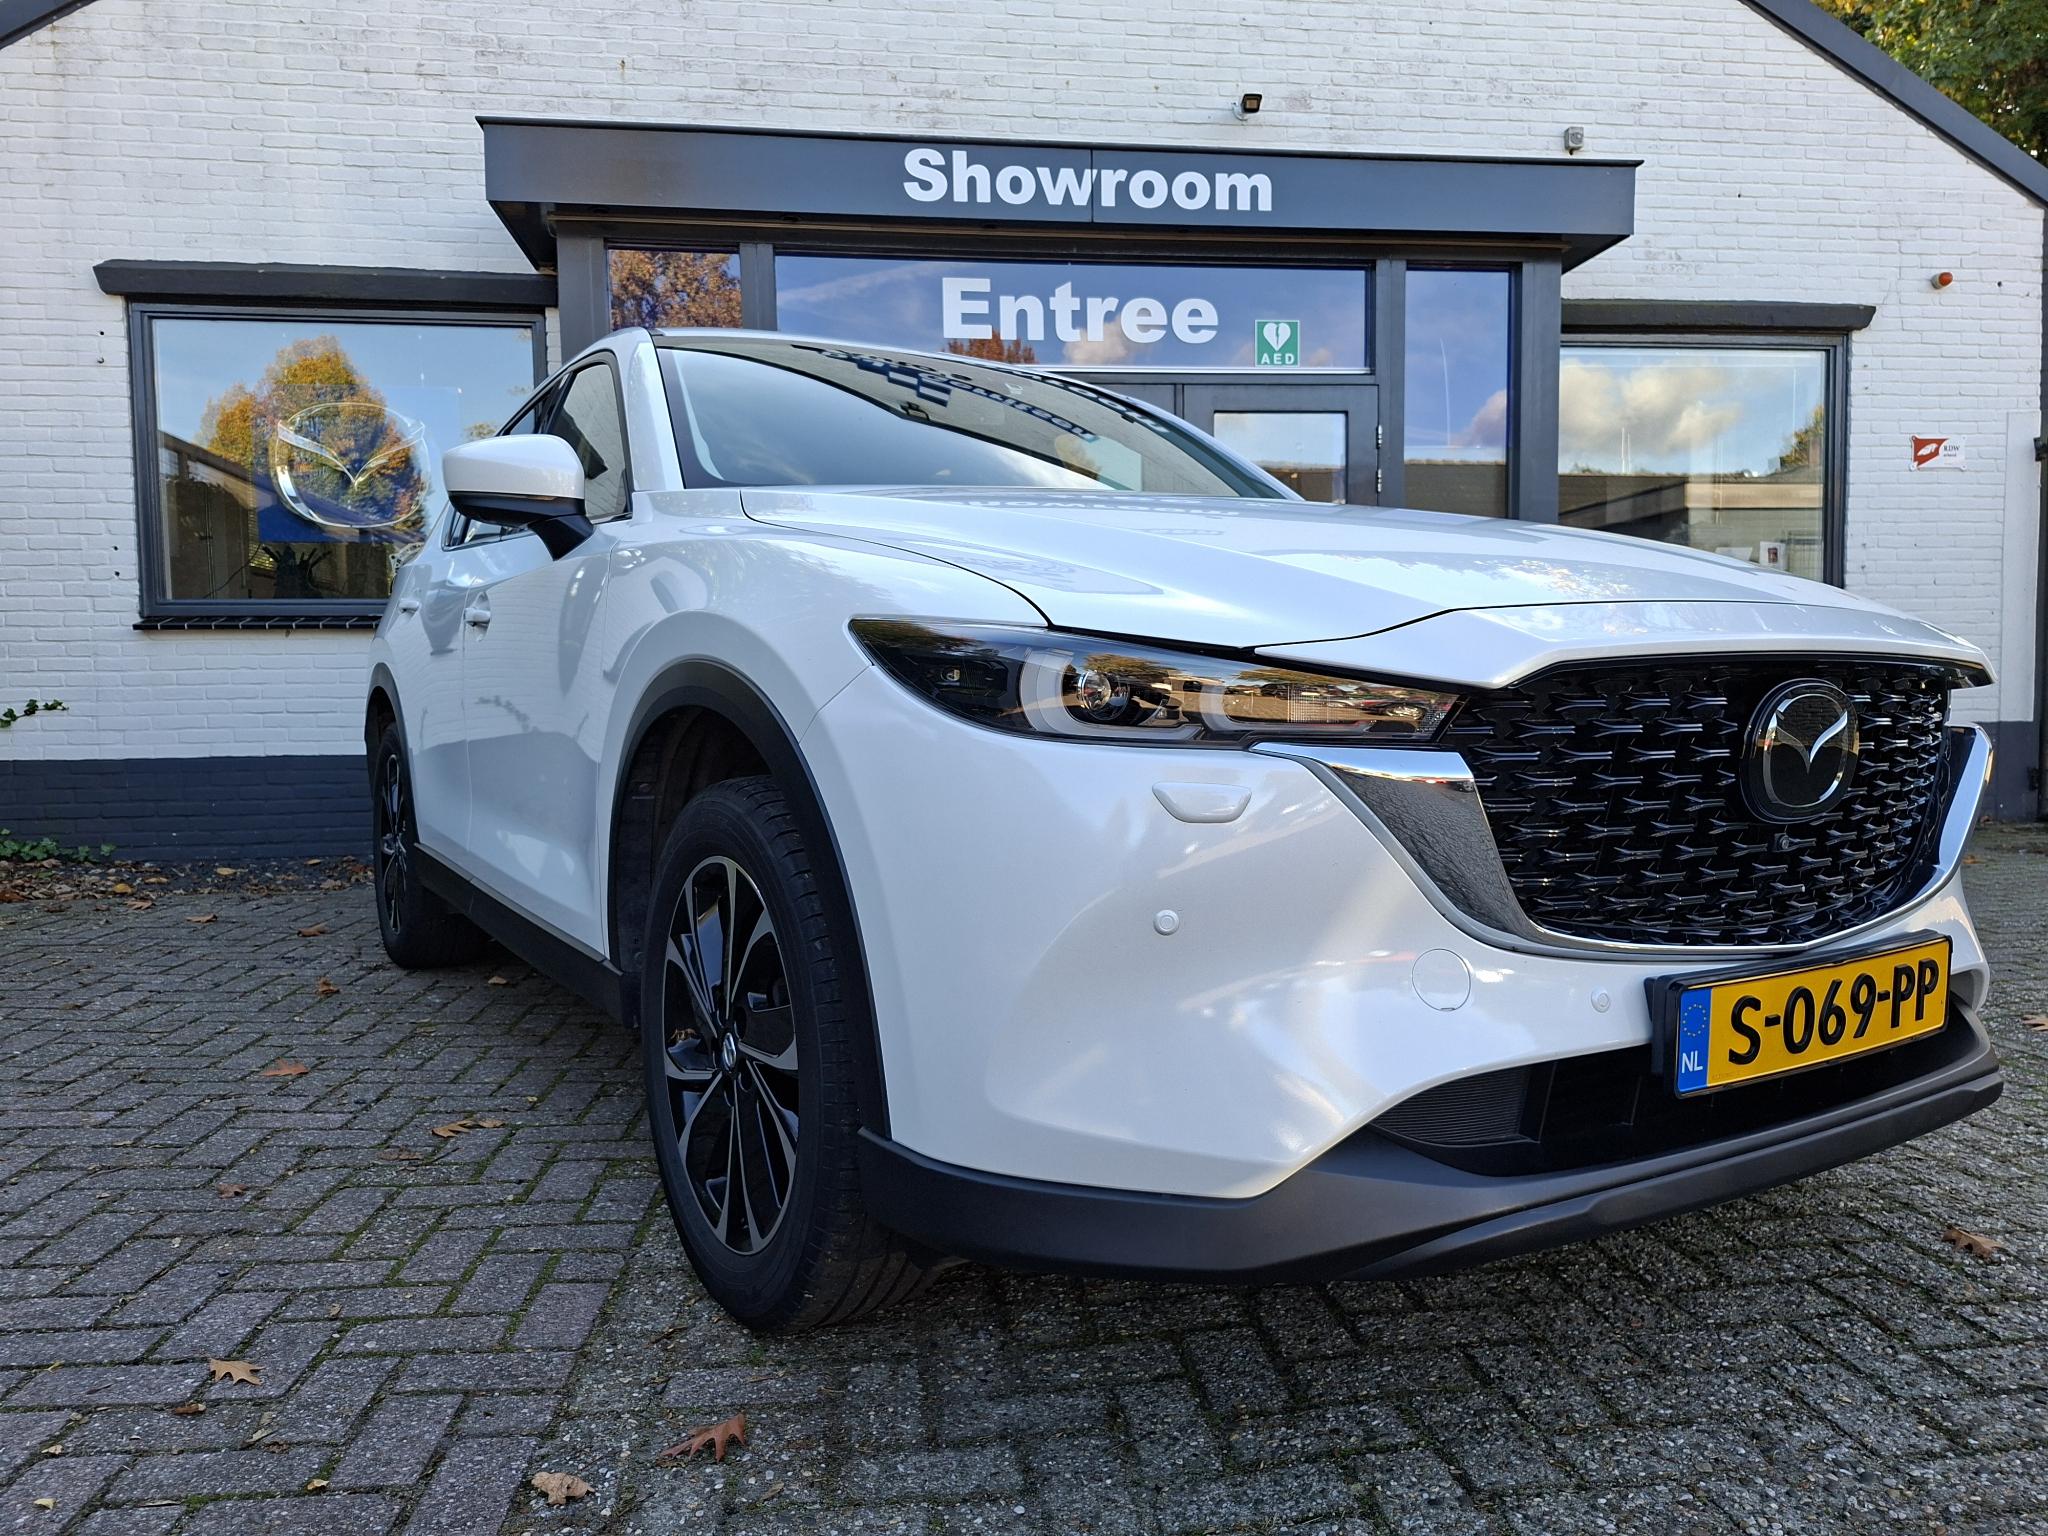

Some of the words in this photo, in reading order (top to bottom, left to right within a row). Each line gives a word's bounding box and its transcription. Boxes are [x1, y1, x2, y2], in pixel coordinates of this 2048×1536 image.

[903, 148, 1272, 211] Showroom
[942, 277, 1219, 344] Entree
[1260, 352, 1295, 365] AED
[1728, 958, 1940, 1065] S-069-PP
[1681, 1050, 1704, 1074] NL
